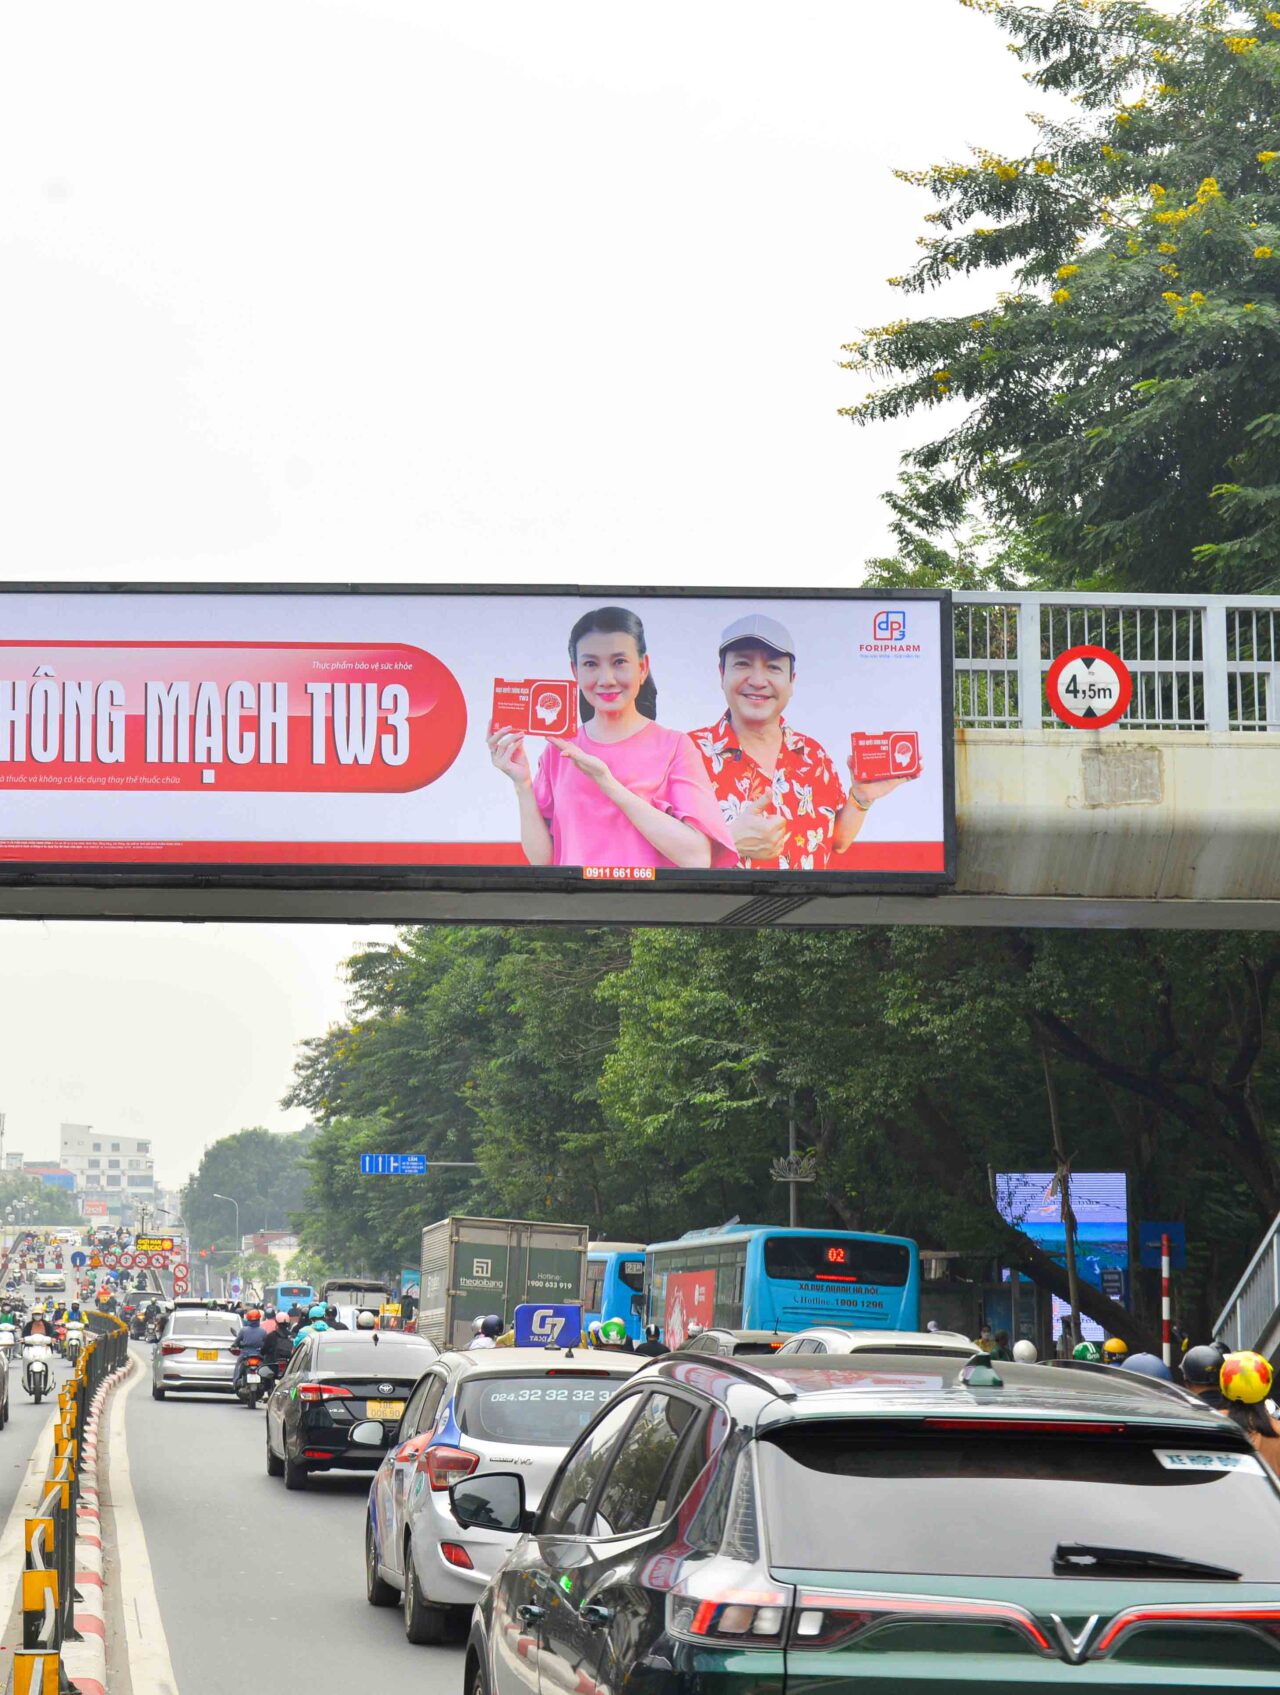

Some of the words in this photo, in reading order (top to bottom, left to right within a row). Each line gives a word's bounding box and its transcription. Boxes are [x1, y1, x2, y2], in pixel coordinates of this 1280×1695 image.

[859, 644, 921, 652] FORIPHARM
[1065, 674, 1112, 700] 4,5m
[145, 681, 289, 784] MẠCH
[305, 682, 411, 767] TW3
[6, 774, 27, 783] thuốc
[39, 774, 62, 785] không
[63, 775, 72, 784] có
[74, 774, 86, 784] tác
[87, 774, 107, 786] dụng
[107, 774, 125, 786] thay
[126, 774, 138, 785] thế
[139, 774, 161, 784] thuốc
[162, 775, 180, 785] chữa
[586, 867, 610, 878] 0911
[613, 868, 631, 878] 661
[633, 868, 652, 878] 666
[827, 1248, 845, 1263] 02
[537, 1272, 562, 1281] Hotline:
[460, 1277, 504, 1289] thegioibang
[527, 1279, 544, 1288] 1900
[544, 1280, 558, 1288] 633
[559, 1281, 572, 1289] 919
[835, 1299, 858, 1307] 1900
[531, 1309, 566, 1342] G7
[529, 1335, 548, 1343] TAXI
[545, 1389, 568, 1401] 32
[572, 1389, 595, 1401] 32
